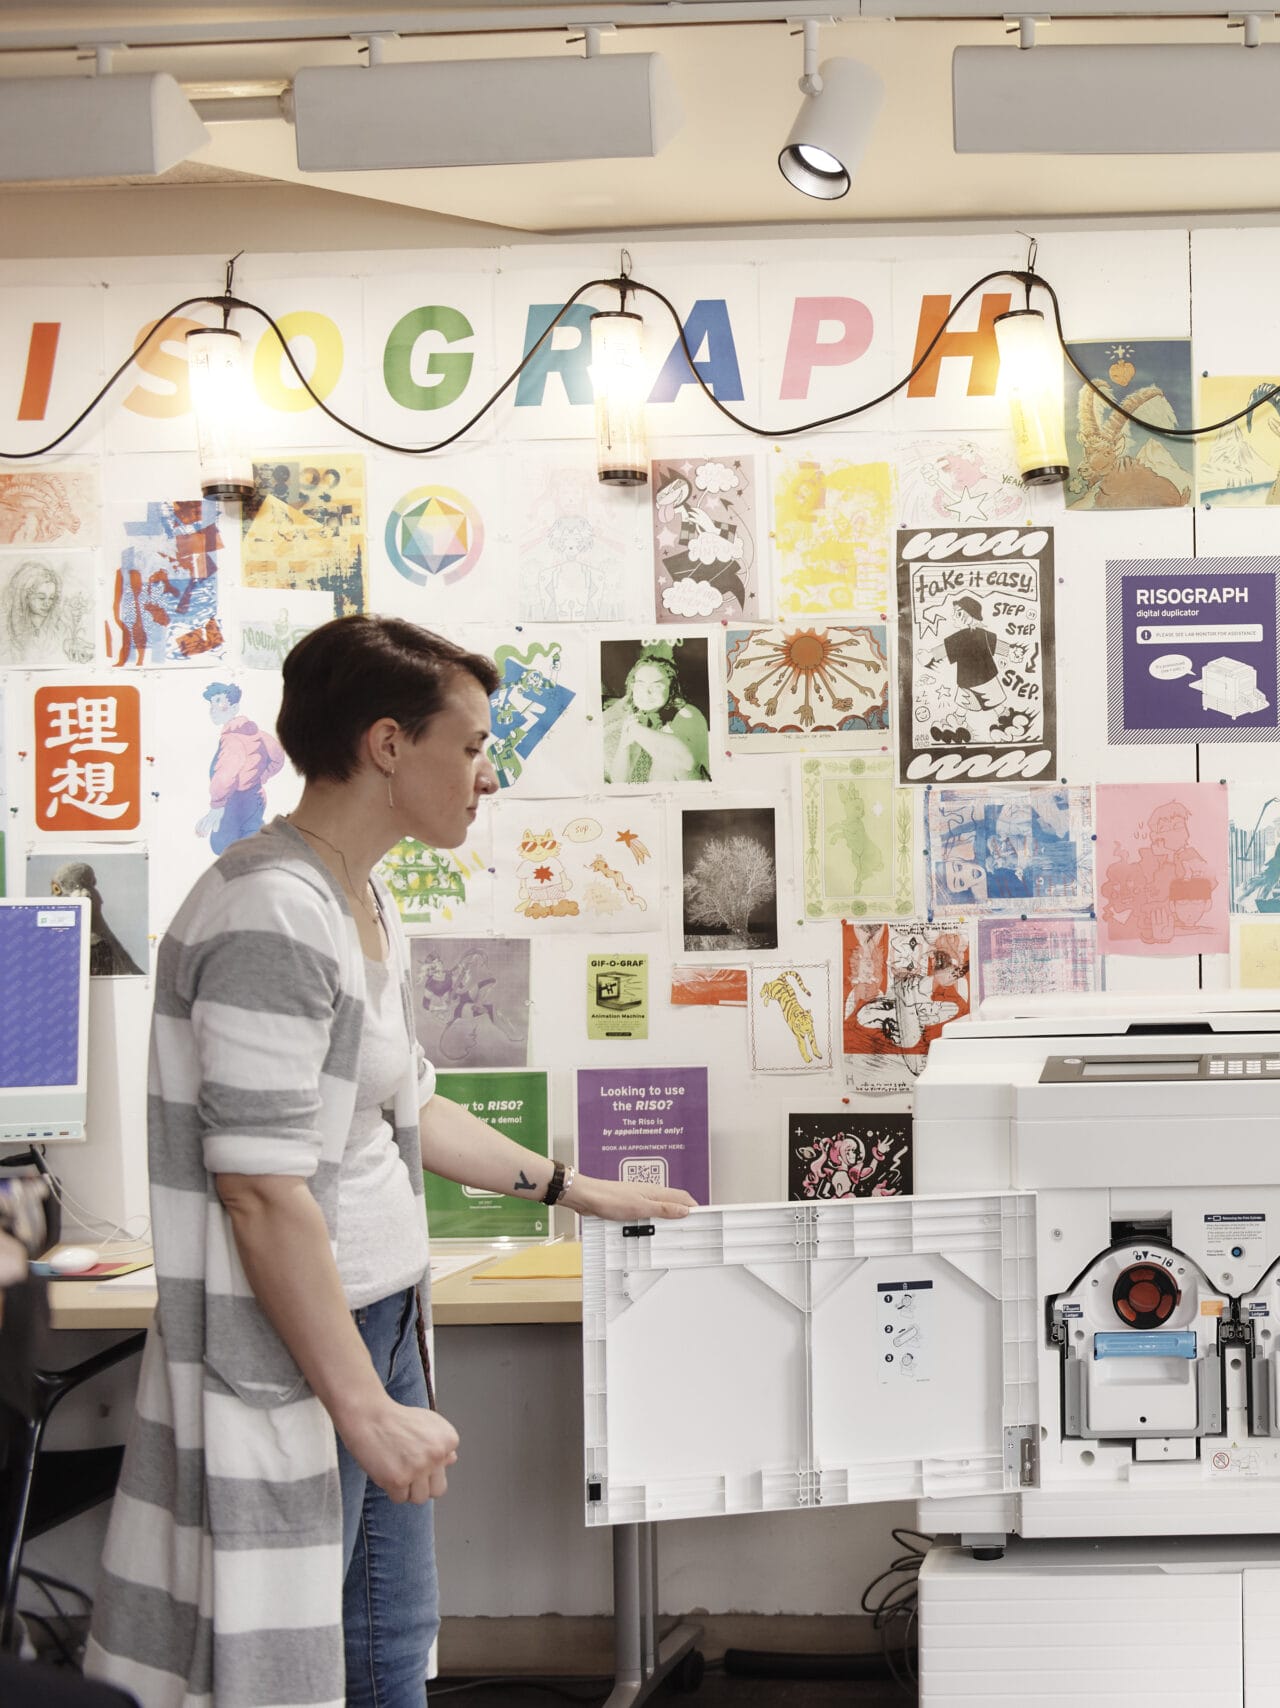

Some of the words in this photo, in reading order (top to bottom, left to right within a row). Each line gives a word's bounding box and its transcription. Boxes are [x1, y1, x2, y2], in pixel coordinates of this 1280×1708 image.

[1136, 587, 1249, 605] RISOGRAPH
[992, 602, 1025, 617] STEP
[1136, 609, 1160, 618] digital
[1161, 608, 1200, 618] duplicator
[1005, 622, 1036, 636] STEP
[44, 696, 131, 820] 理想
[600, 1086, 646, 1098] Looking
[649, 1085, 661, 1096] to
[665, 1086, 686, 1096] use
[473, 1102, 485, 1111] to
[488, 1100, 523, 1111] RISO?
[613, 1101, 632, 1111] the
[635, 1100, 673, 1111] RISO?
[622, 1118, 637, 1126] The
[657, 1117, 664, 1125] is
[603, 1128, 612, 1137] by
[614, 1127, 662, 1137] appointment
[664, 1127, 684, 1136] only!
